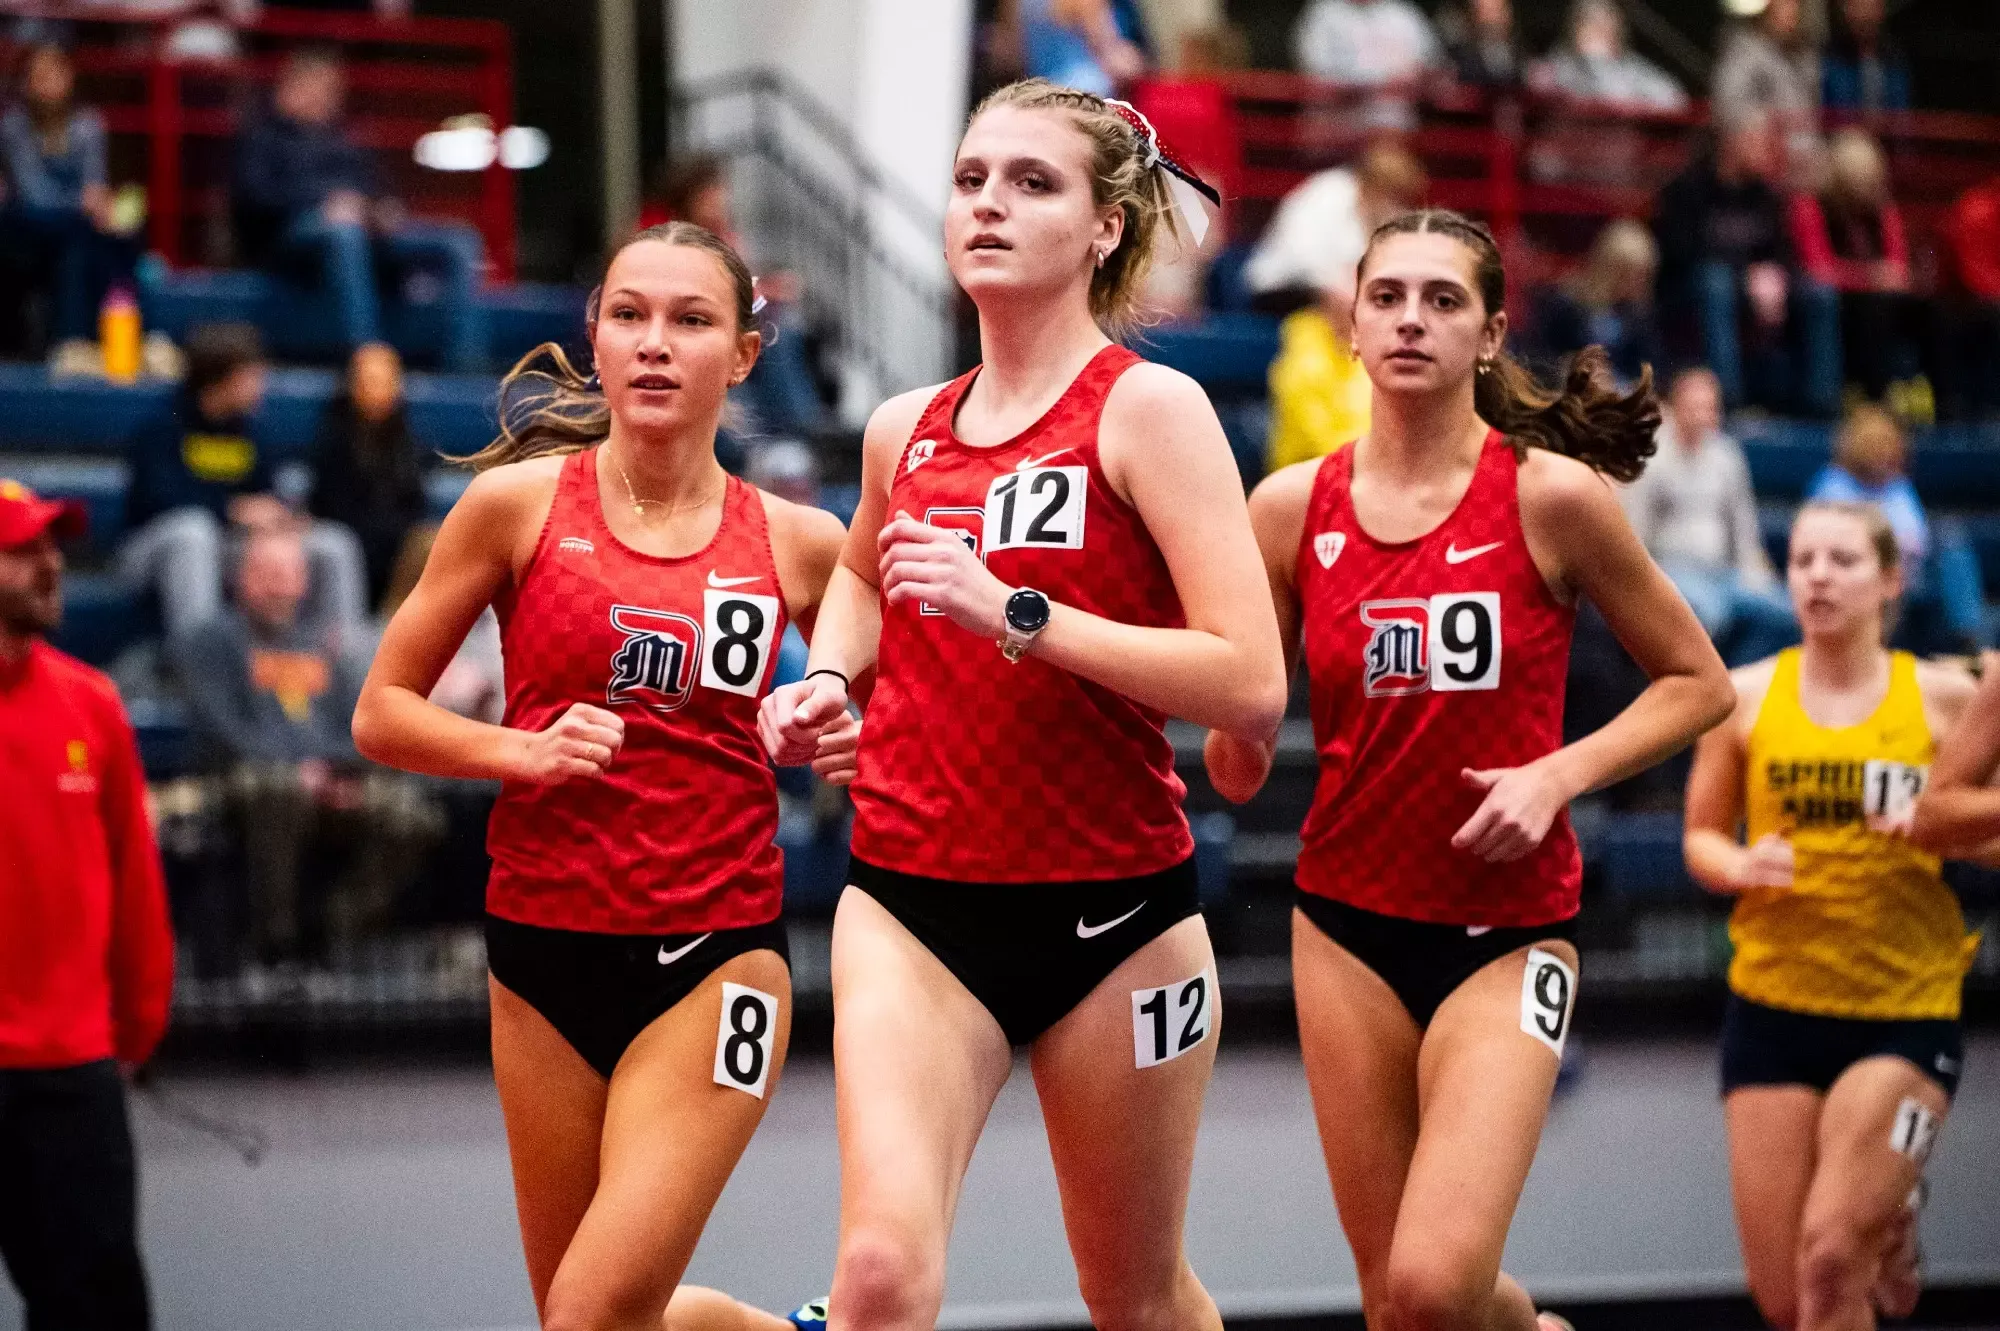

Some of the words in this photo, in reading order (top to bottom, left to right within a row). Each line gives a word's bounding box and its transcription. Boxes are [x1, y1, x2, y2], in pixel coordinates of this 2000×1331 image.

[993, 470, 1070, 545] 12
[712, 599, 764, 687] 8
[1441, 600, 1493, 683] 9
[724, 994, 768, 1086] 8
[1140, 976, 1205, 1061] 12
[1534, 963, 1568, 1042] 9
